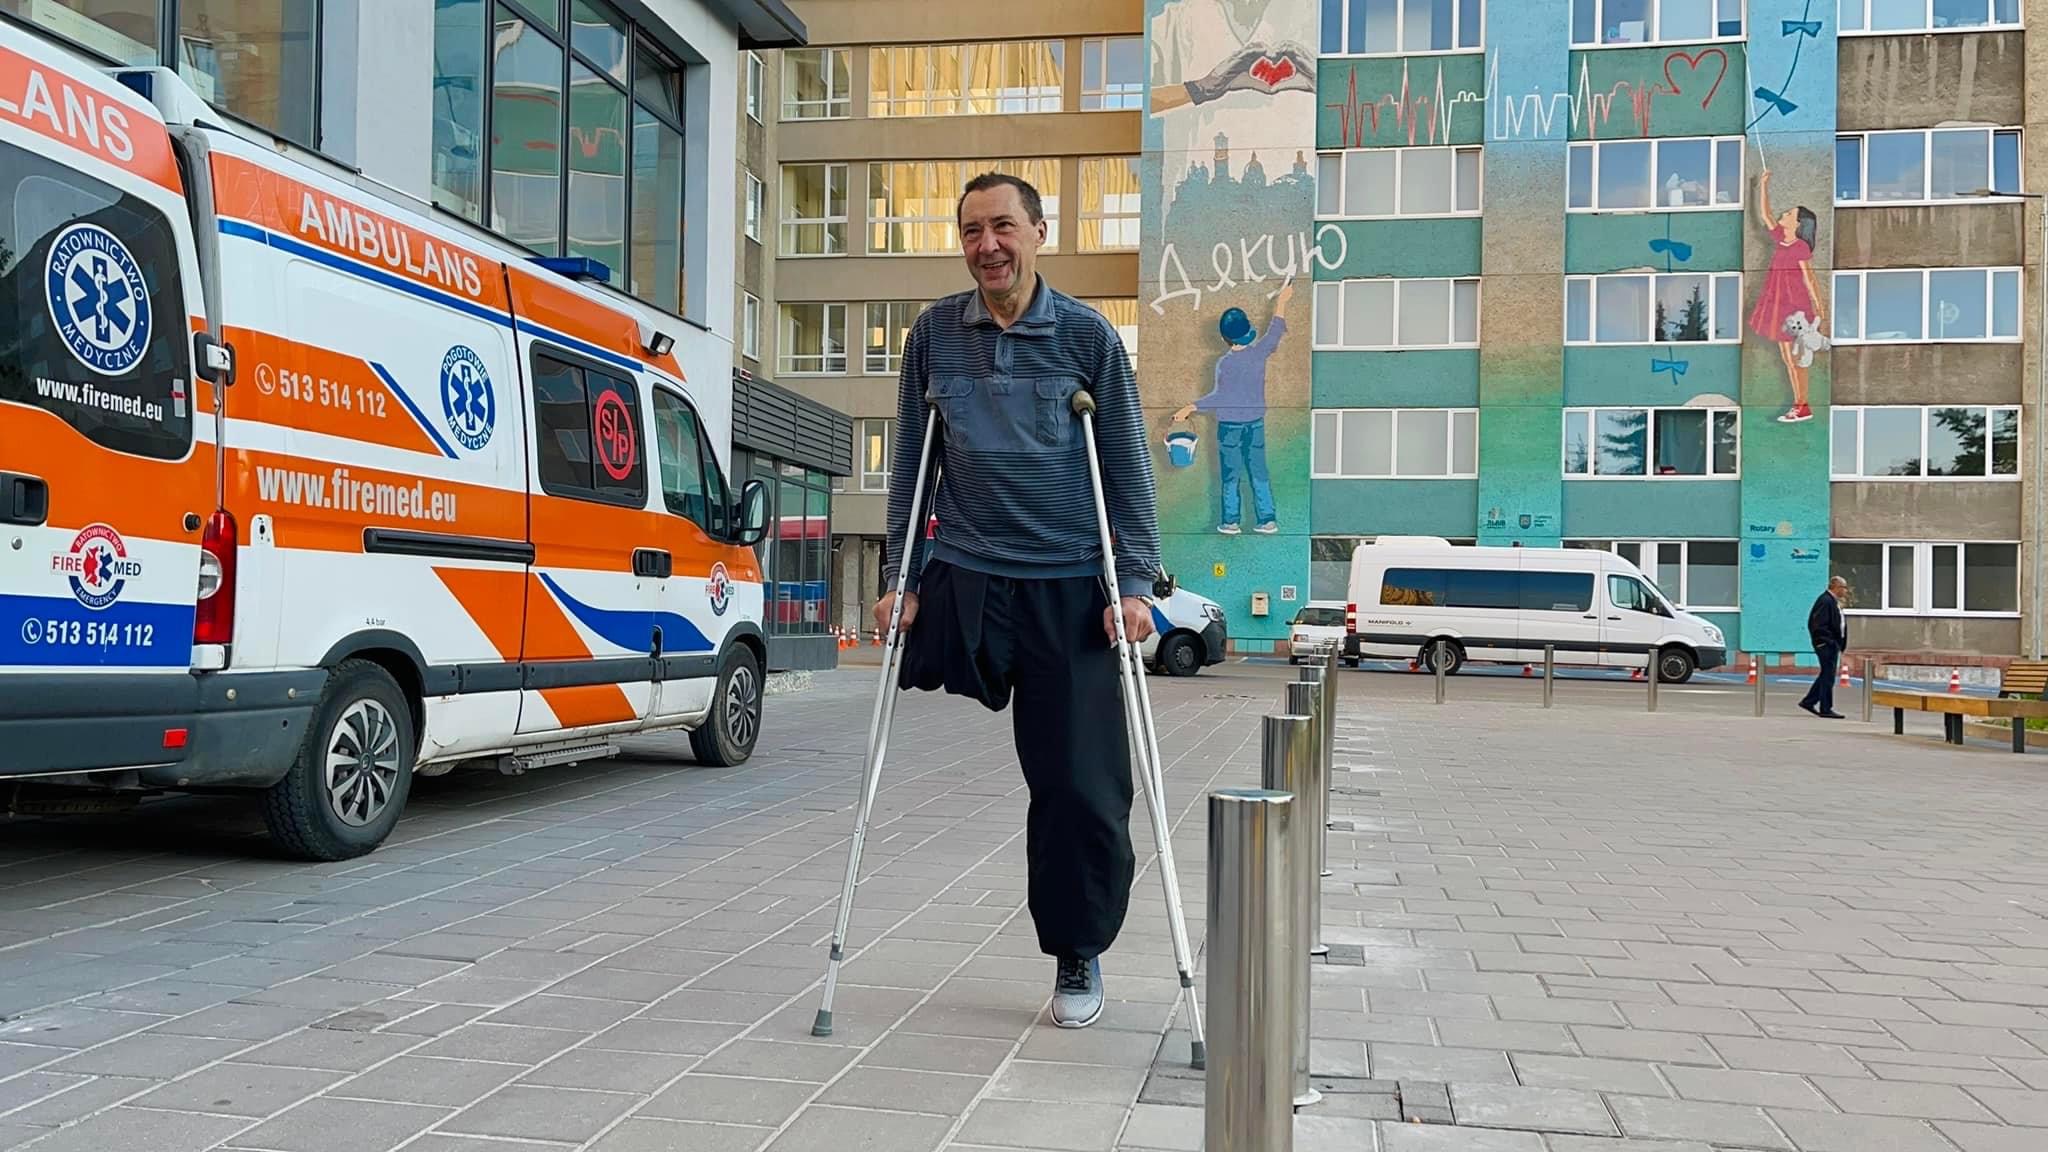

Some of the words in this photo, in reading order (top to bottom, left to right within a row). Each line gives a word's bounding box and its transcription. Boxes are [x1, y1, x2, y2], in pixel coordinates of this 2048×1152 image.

[52, 231, 144, 301] RATOWNICTWO
[300, 192, 481, 297] AMBULANS
[1150, 224, 1347, 315] Дякую
[63, 322, 140, 369] MEDYCZNE
[443, 347, 489, 383] POGOTOWIE
[37, 377, 163, 422] www.firemed.eu
[280, 369, 314, 402] 513
[320, 379, 351, 410] 514
[356, 388, 386, 418] 112
[447, 415, 493, 449] MEDYCZNE
[257, 466, 456, 522] www.firemed.eu
[1750, 524, 1775, 533] Rotary
[52, 556, 82, 572] FIRE
[114, 561, 141, 576] MED
[76, 587, 116, 606] EMERGENCY
[46, 620, 81, 645] 513
[86, 621, 118, 646] 514
[123, 623, 154, 647] 112
